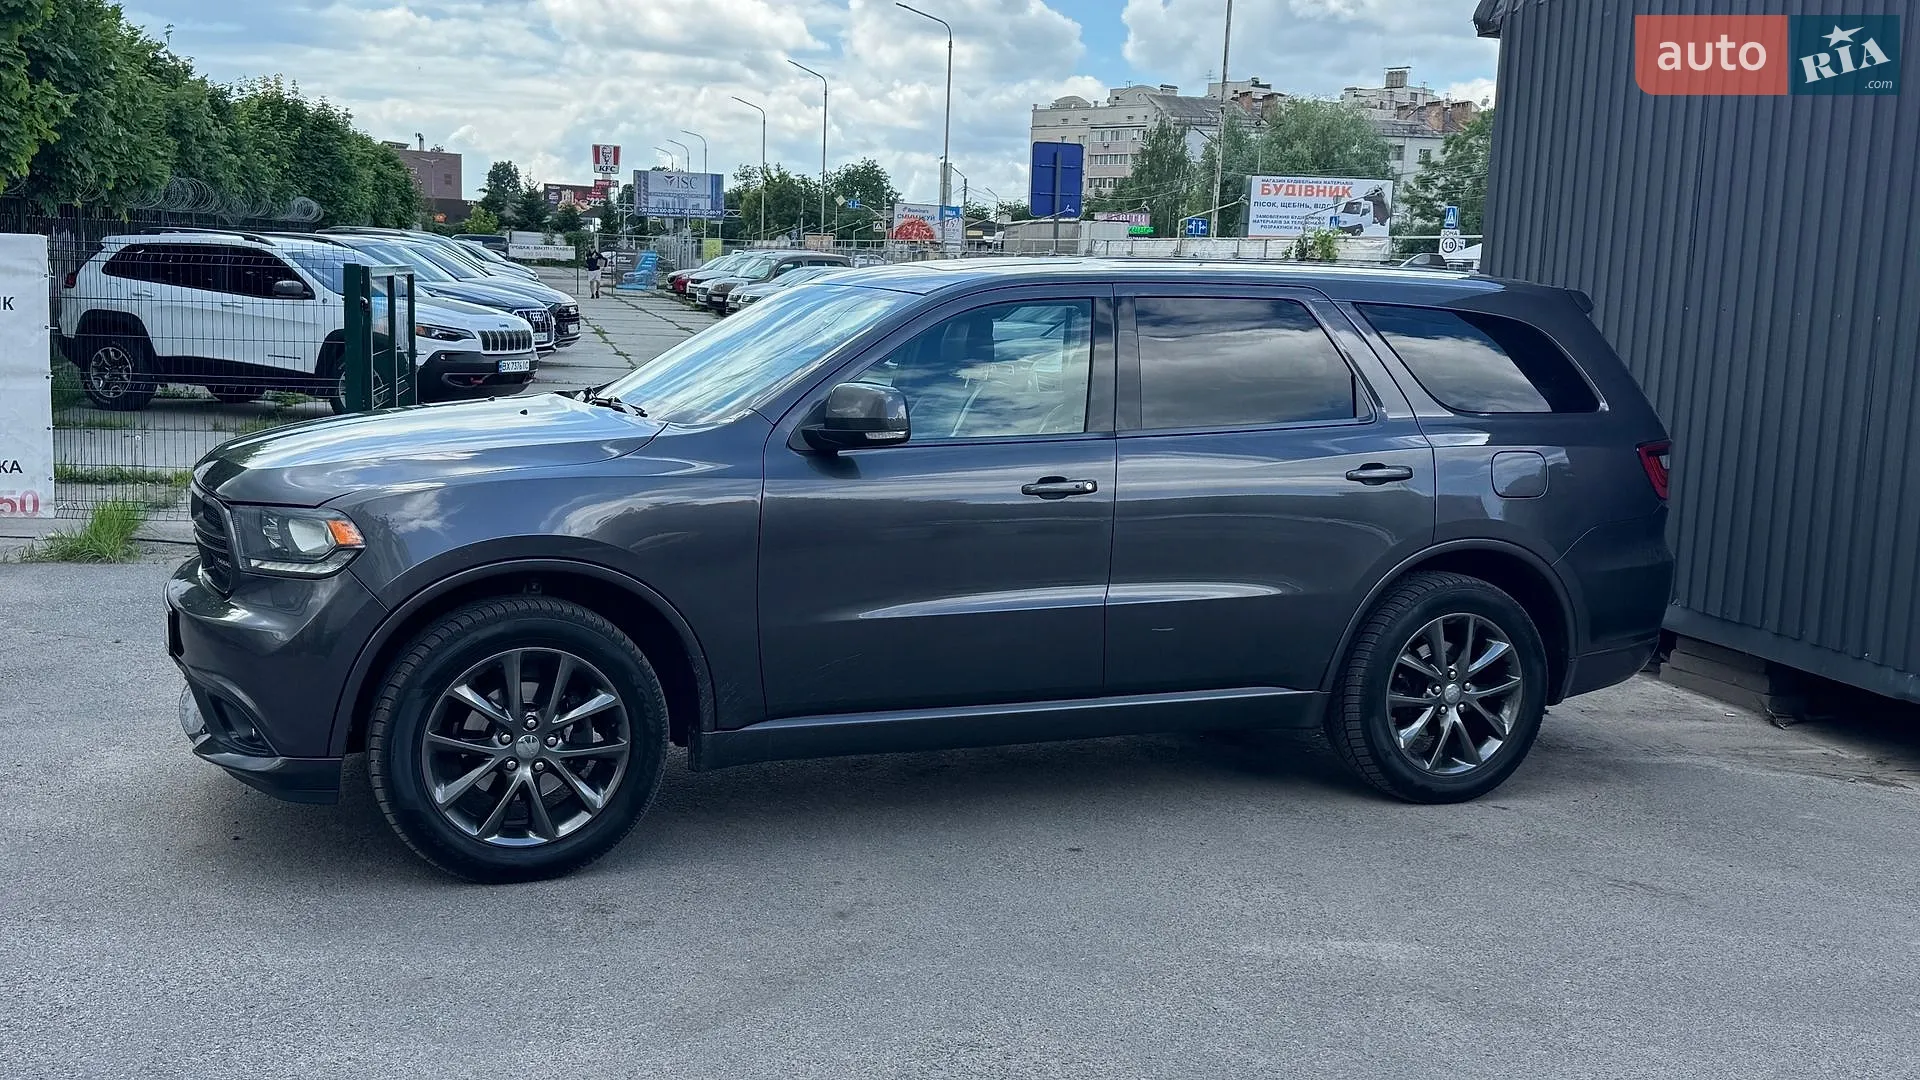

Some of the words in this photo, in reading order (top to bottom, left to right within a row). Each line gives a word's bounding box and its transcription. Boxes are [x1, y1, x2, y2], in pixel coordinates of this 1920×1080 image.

[1261, 183, 1353, 198] БУДІВНИК
[1280, 201, 1312, 209] ЩЕБІНЬ,
[1445, 241, 1454, 249] 10
[0, 296, 15, 311] К
